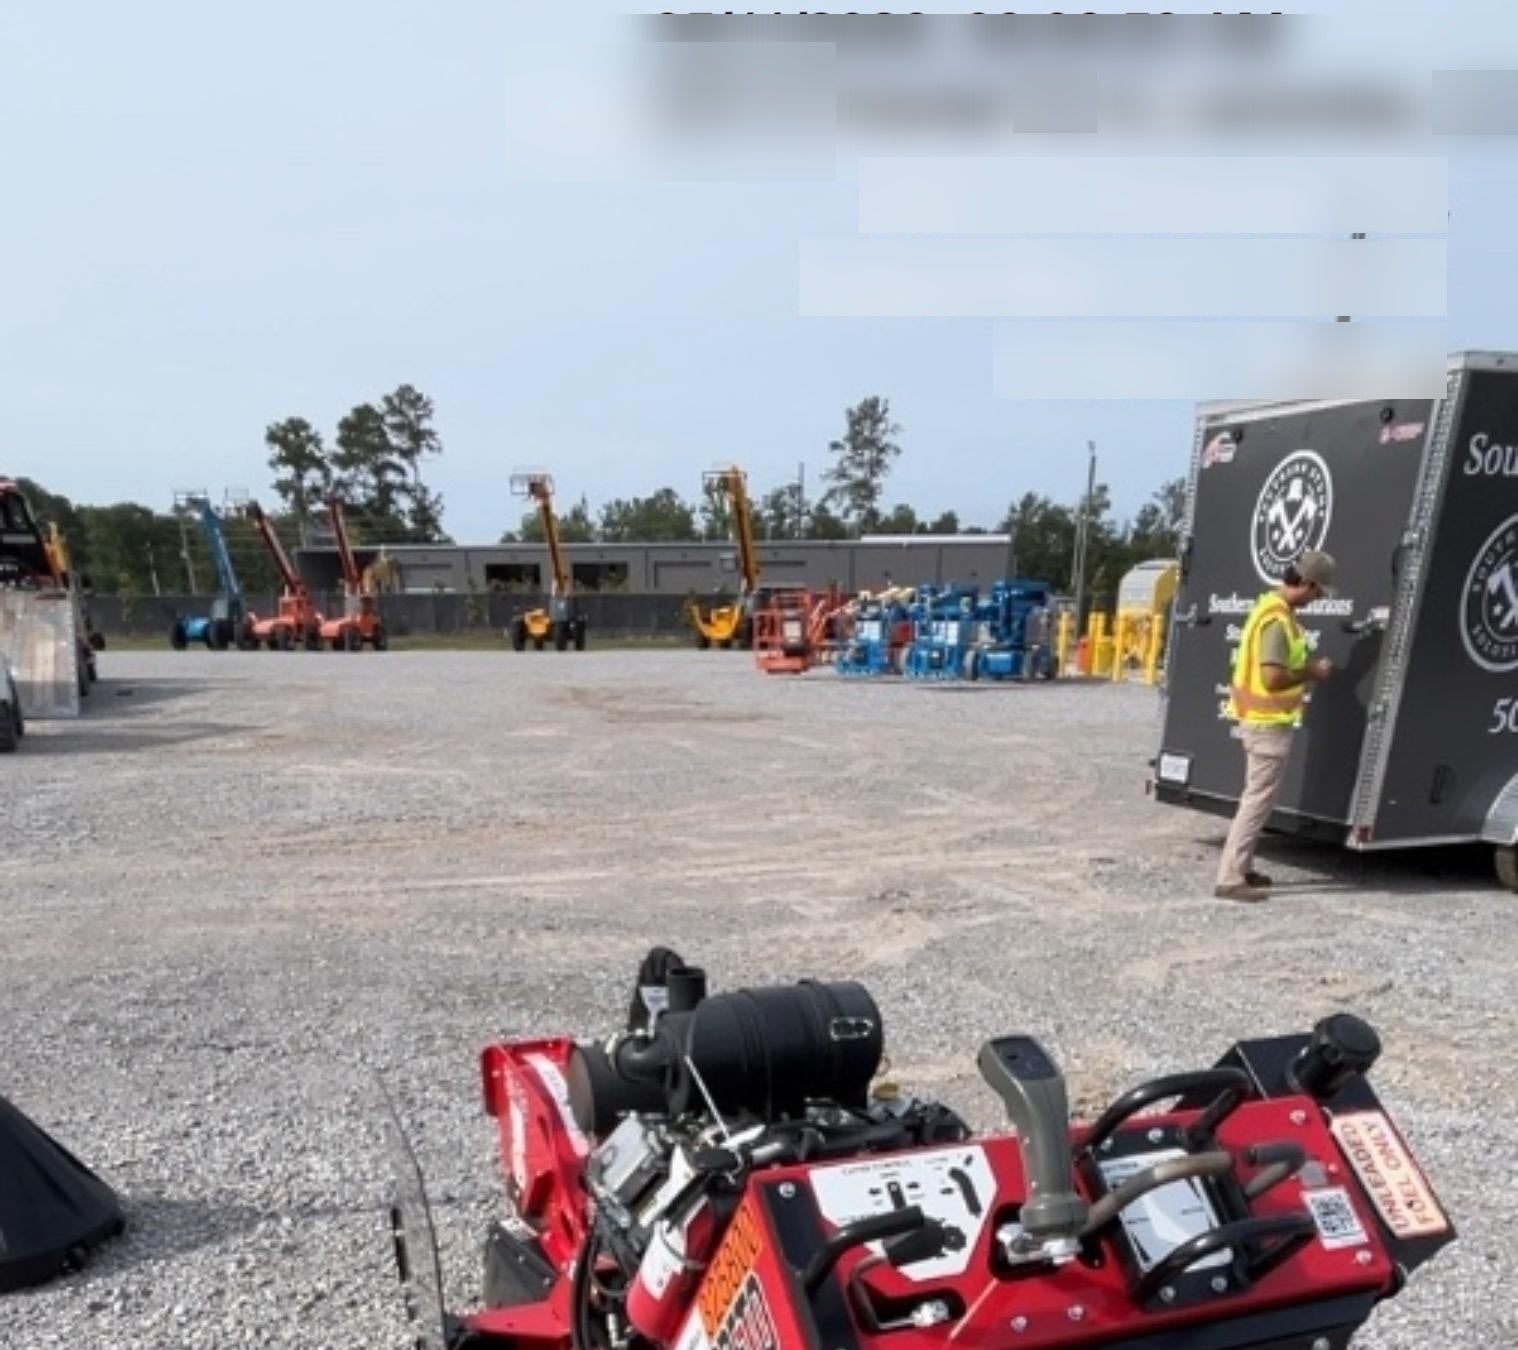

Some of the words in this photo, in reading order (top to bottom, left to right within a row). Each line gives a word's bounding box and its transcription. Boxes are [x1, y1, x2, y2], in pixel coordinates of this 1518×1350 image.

[1361, 1120, 1402, 1171] ONLY
[1341, 1121, 1412, 1228] UNLEADED
[1397, 1173, 1436, 1224] FUEL
